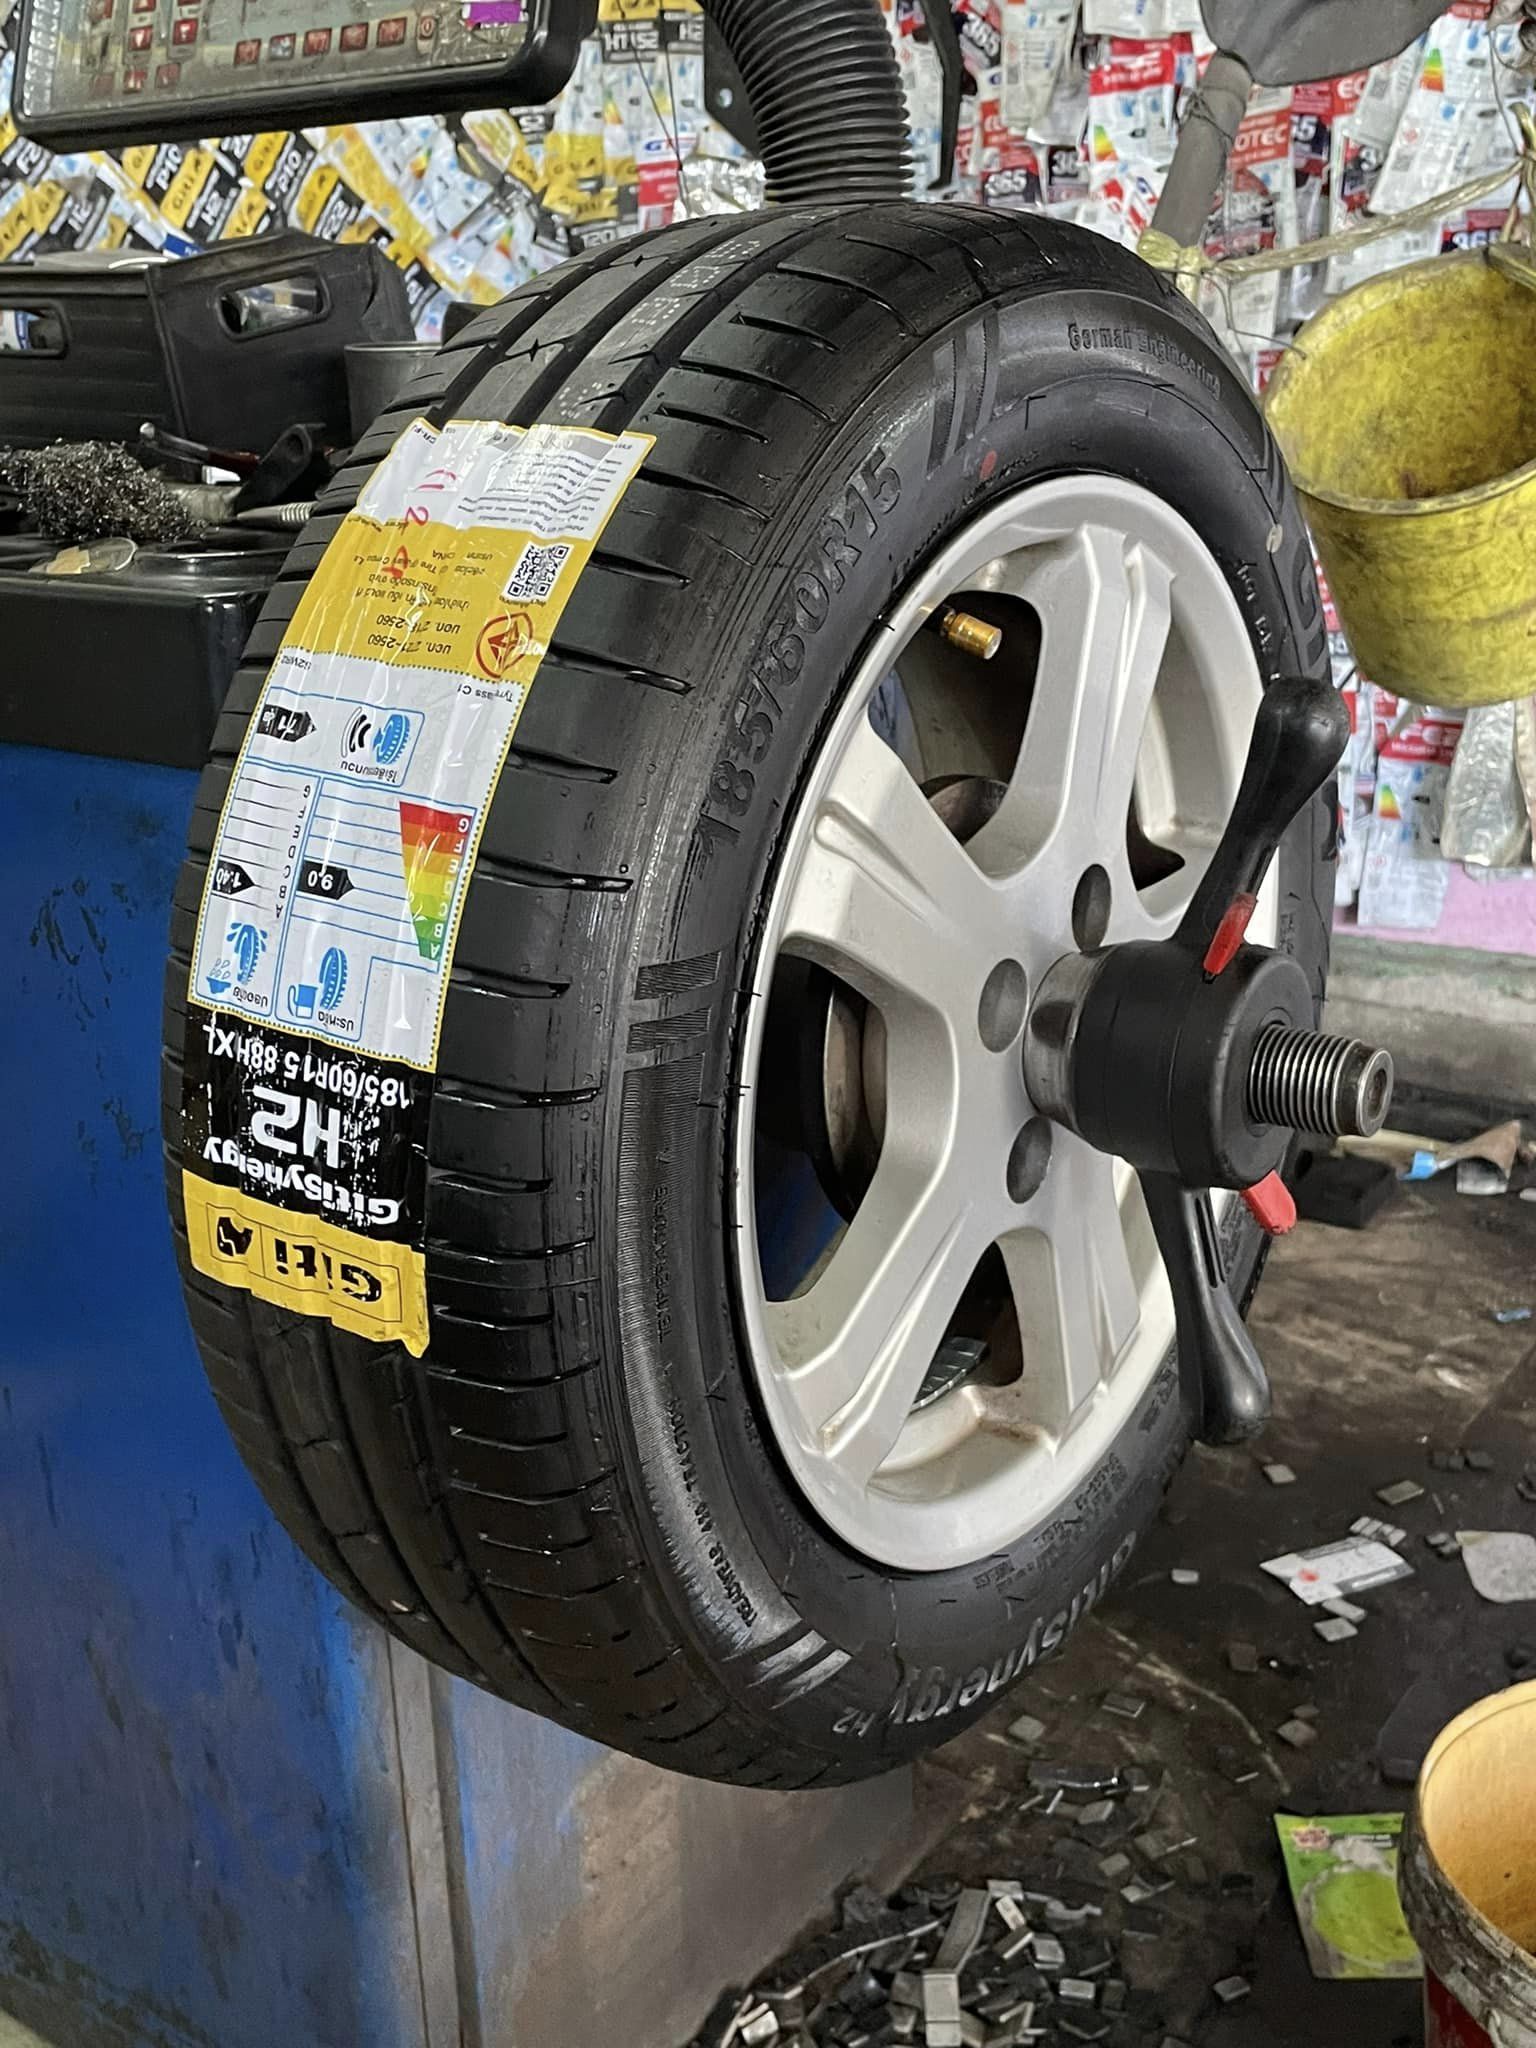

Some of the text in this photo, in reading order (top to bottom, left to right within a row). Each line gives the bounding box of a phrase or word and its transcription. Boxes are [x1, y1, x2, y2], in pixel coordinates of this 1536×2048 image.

[1068, 322, 1132, 351] German
[699, 446, 901, 848] 185/60R15
[284, 1051, 412, 1110] 185/60R15
[251, 1085, 342, 1170] H2
[274, 1239, 382, 1303] Giti
[708, 1541, 760, 1628] TREADWEAR
[832, 1710, 877, 1739] H2
